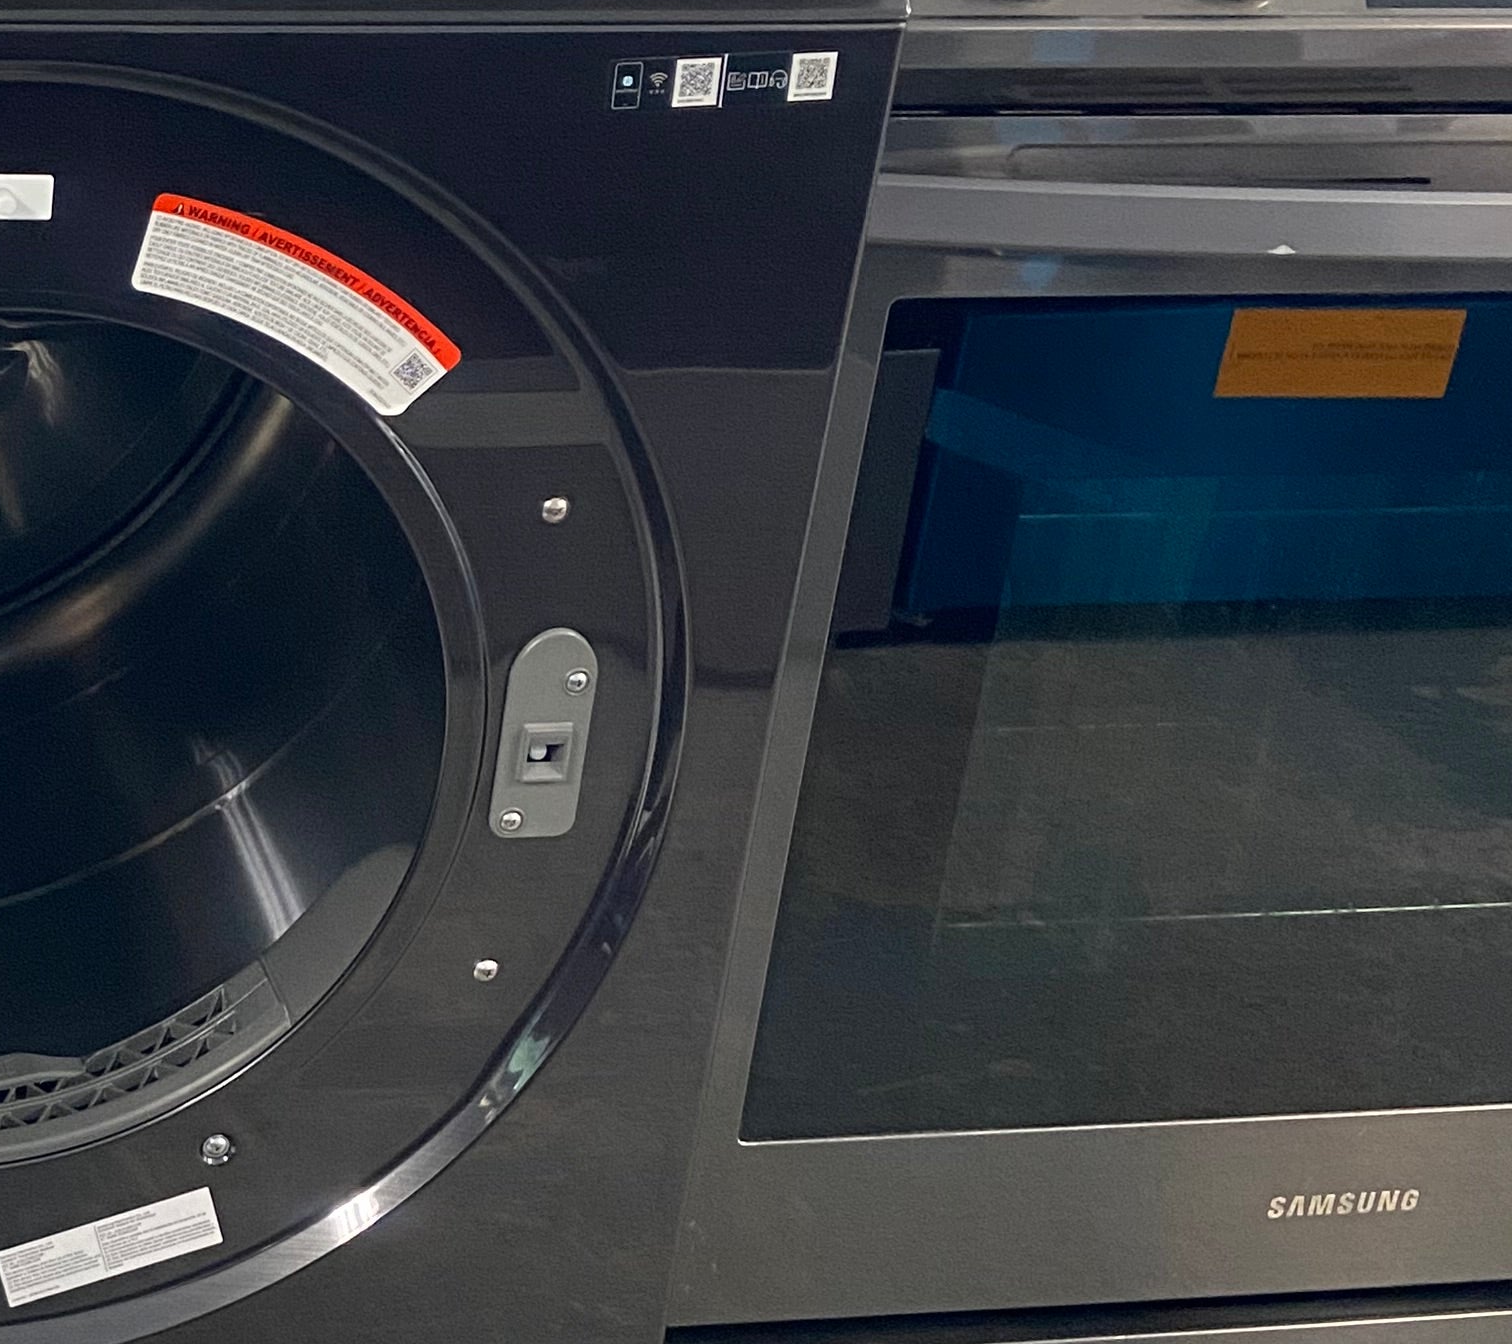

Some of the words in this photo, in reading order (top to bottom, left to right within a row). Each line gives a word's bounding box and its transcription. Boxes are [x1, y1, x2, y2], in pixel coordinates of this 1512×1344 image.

[188, 204, 252, 236] WARNING
[257, 231, 361, 287] AVERTISSEMENT
[363, 288, 438, 349] ADVERTENCIA
[1267, 1188, 1421, 1219] SAMSUNG
